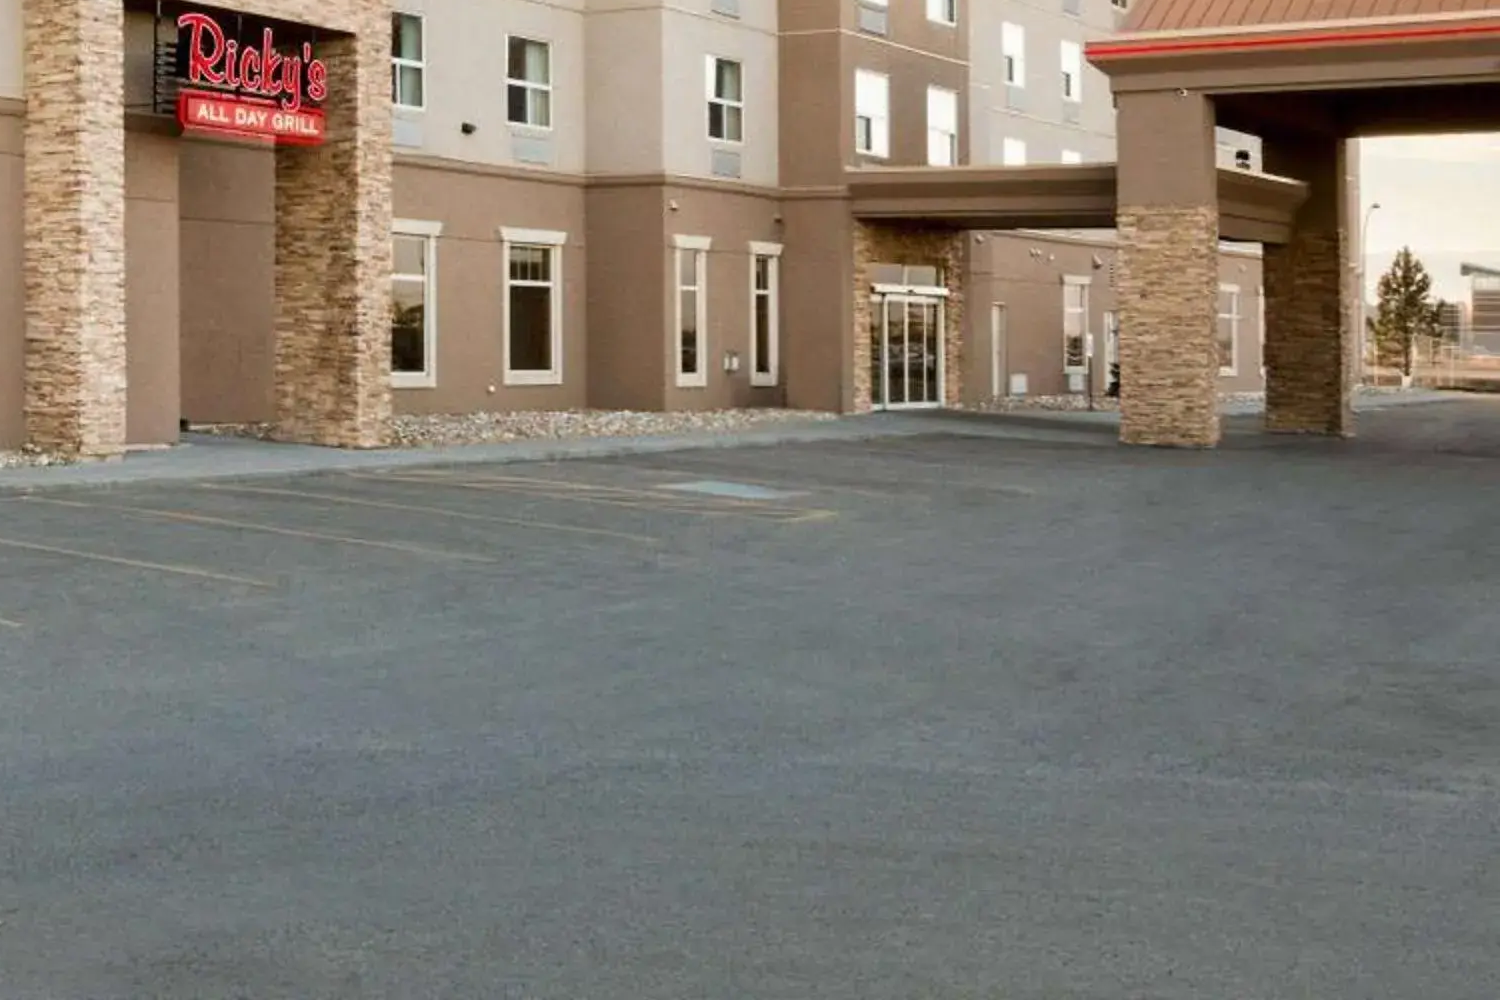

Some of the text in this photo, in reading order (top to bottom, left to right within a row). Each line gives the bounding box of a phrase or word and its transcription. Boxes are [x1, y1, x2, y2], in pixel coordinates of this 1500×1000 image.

[177, 12, 328, 112] Ricky's
[197, 103, 319, 134] ALL DAY GRILL
